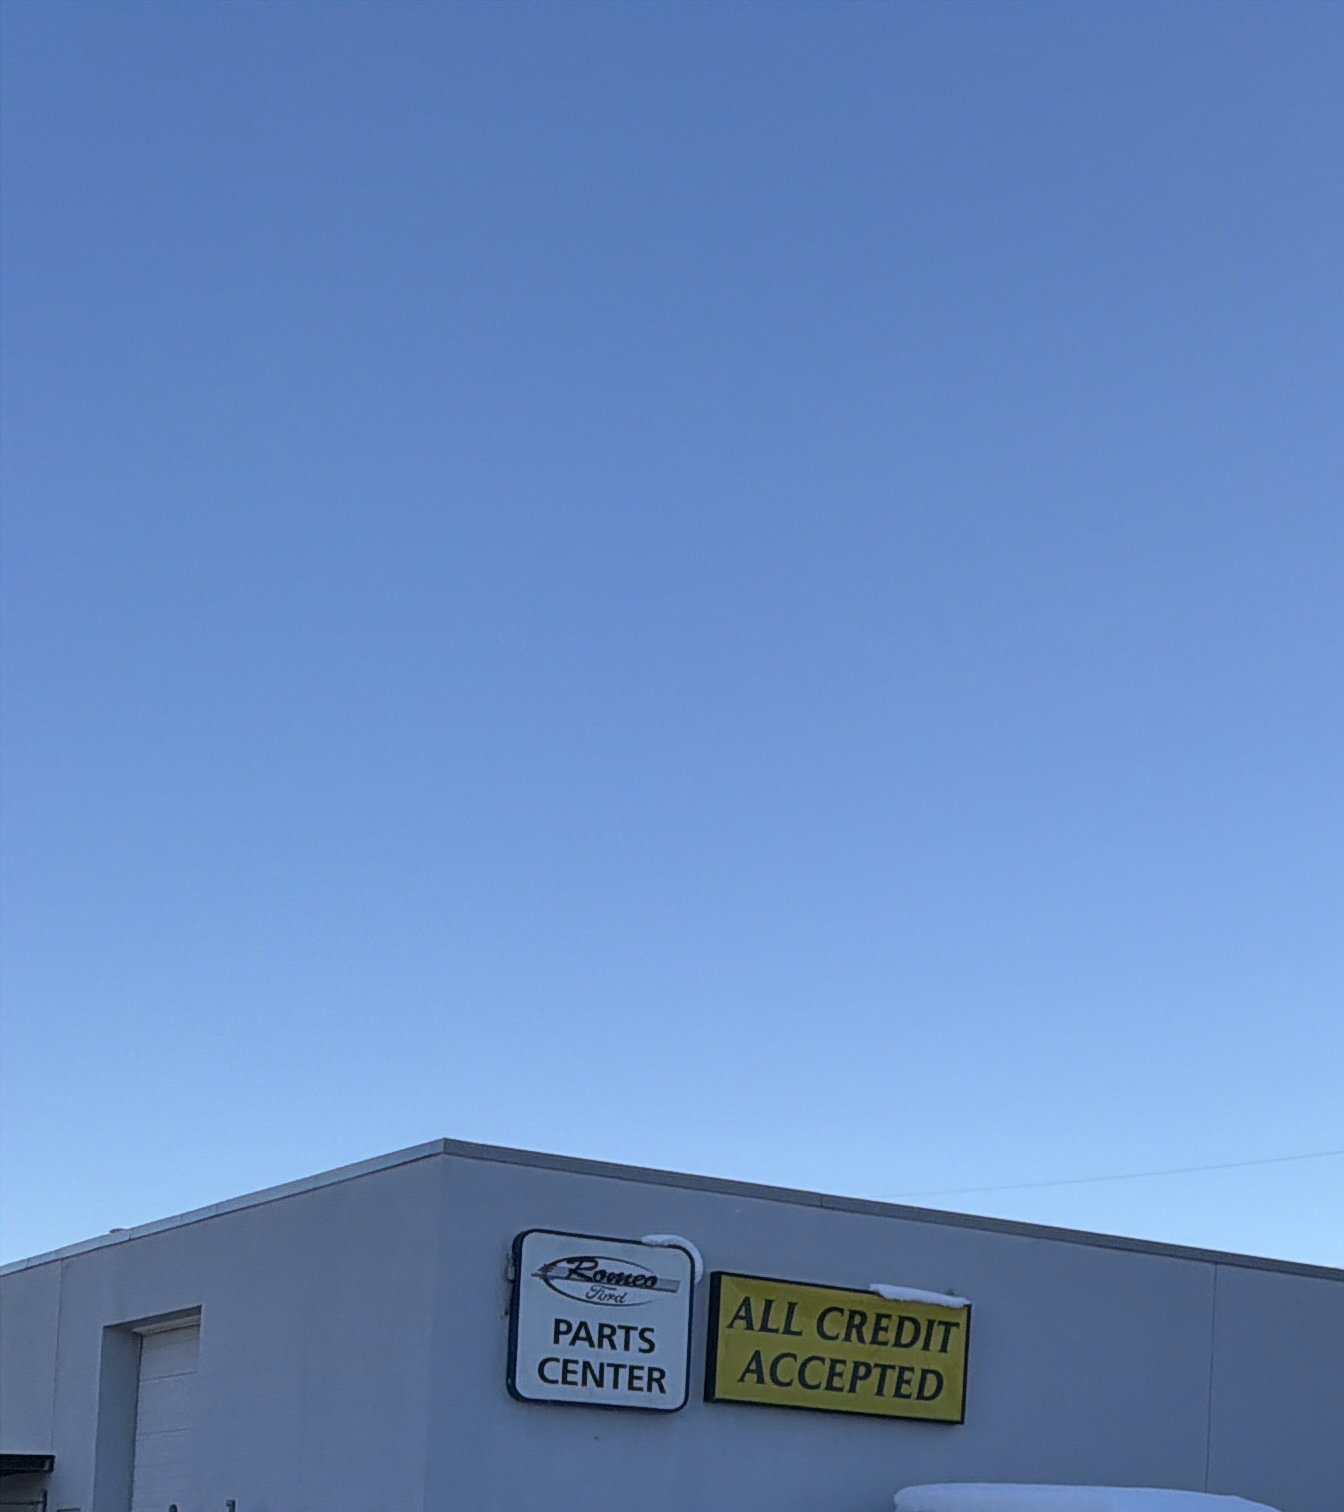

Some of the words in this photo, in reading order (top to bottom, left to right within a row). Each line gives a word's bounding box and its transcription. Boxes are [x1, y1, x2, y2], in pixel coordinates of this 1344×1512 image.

[564, 1257, 658, 1289] Romeo
[585, 1286, 628, 1304] Ford
[553, 1318, 656, 1354] PARTS
[726, 1296, 803, 1337] ALL
[816, 1306, 960, 1354] CREDIT
[537, 1357, 666, 1394] CENTER
[737, 1350, 944, 1401] ACCEPTED
